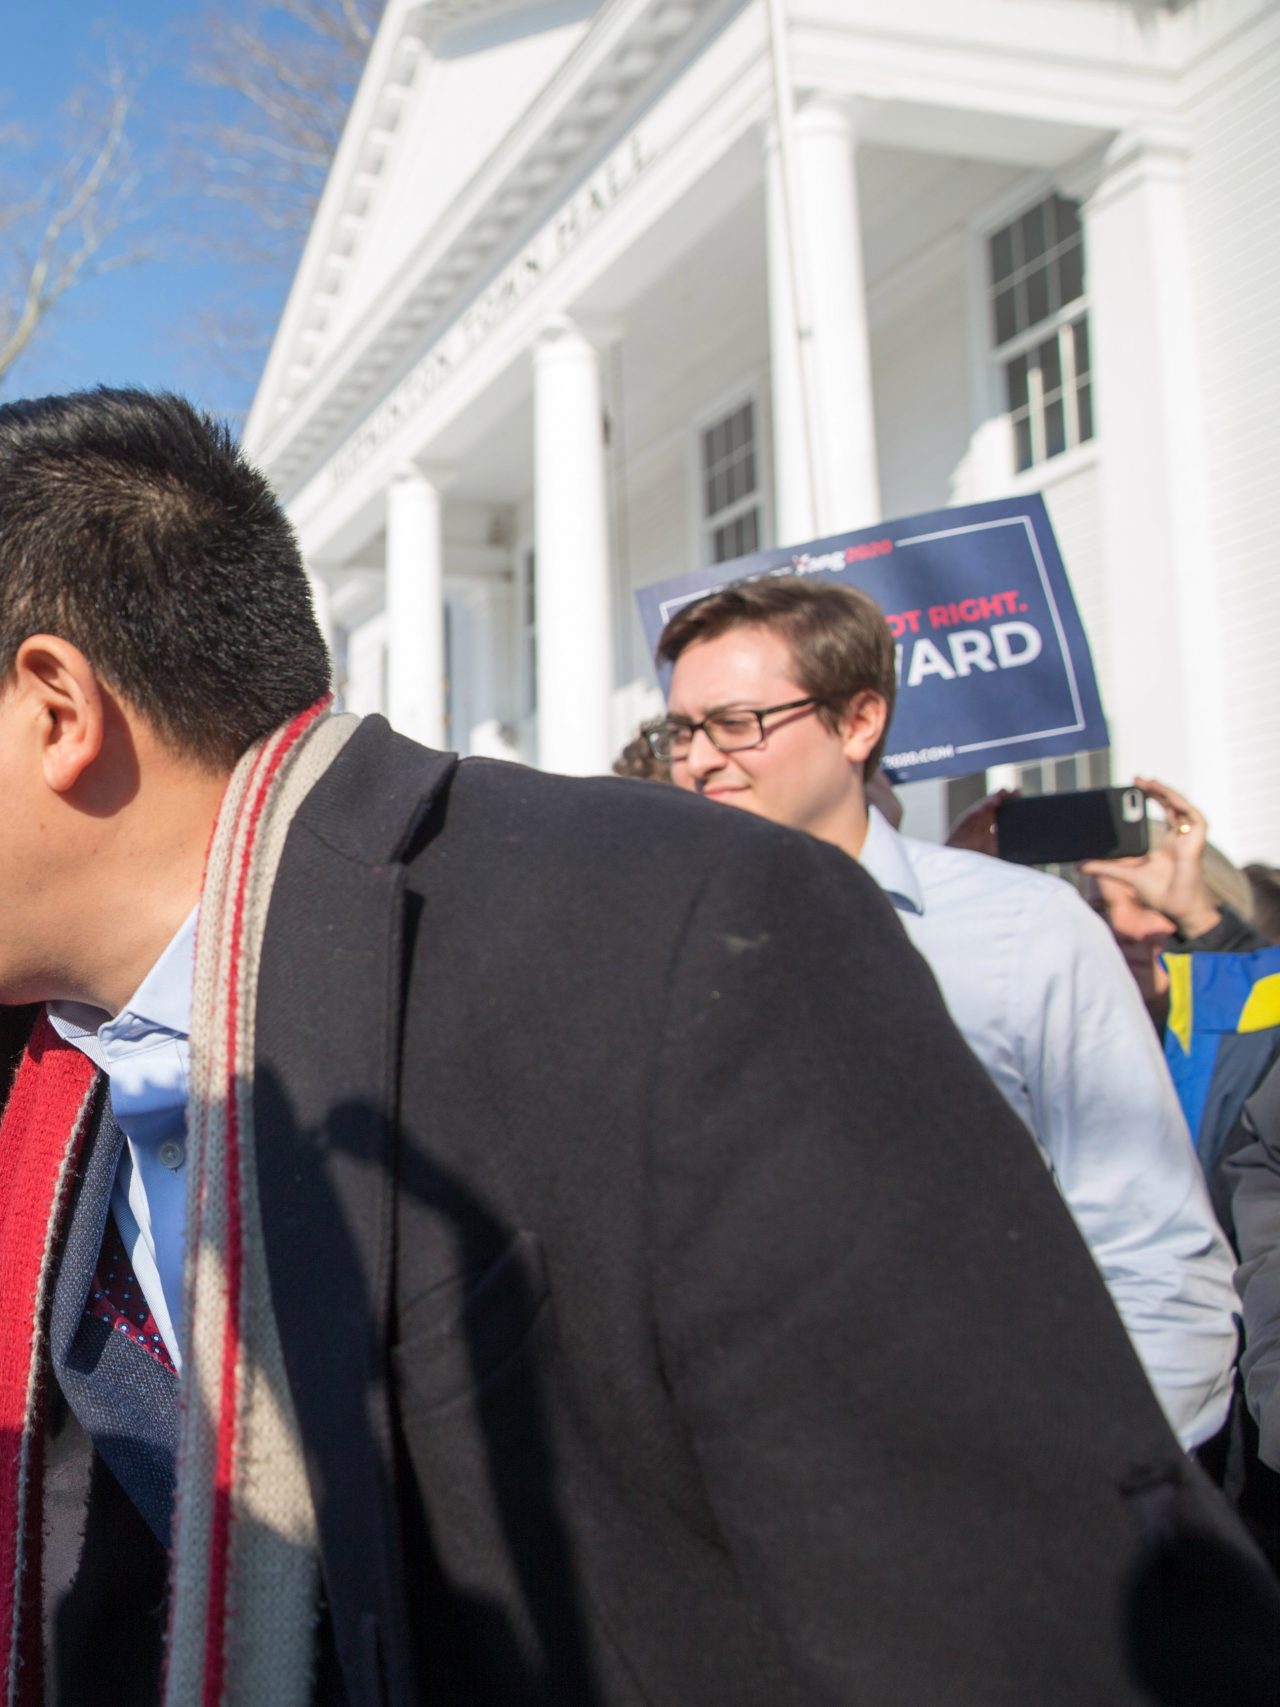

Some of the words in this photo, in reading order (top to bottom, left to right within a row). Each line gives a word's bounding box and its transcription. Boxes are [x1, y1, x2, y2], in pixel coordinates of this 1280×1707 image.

[885, 610, 921, 638] OT
[928, 591, 1028, 629] RIGHT.
[894, 620, 1043, 690] ARD
[882, 744, 955, 769] 2020.COM
